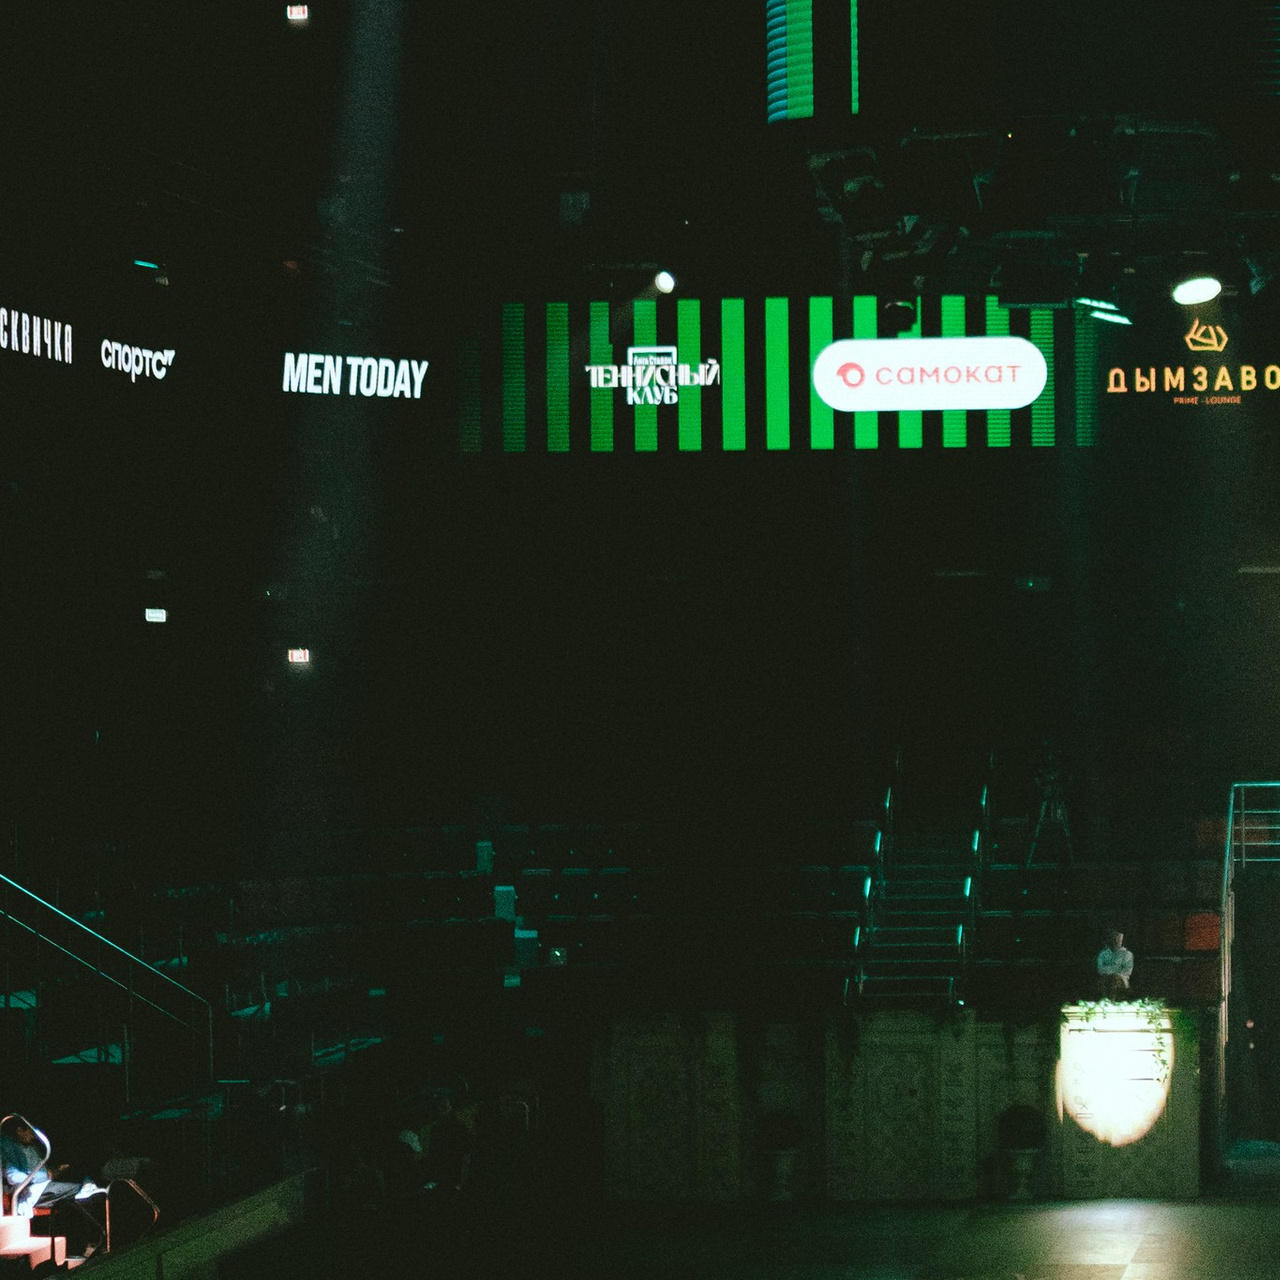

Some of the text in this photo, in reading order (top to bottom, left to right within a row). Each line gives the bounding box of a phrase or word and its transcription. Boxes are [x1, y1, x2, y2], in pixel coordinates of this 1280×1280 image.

[283, 352, 429, 400] MEN TODAY
[584, 358, 721, 388] ТЕННИСНЫЙ
[875, 364, 1022, 387] самокат
[626, 386, 679, 406] КЛУБ
